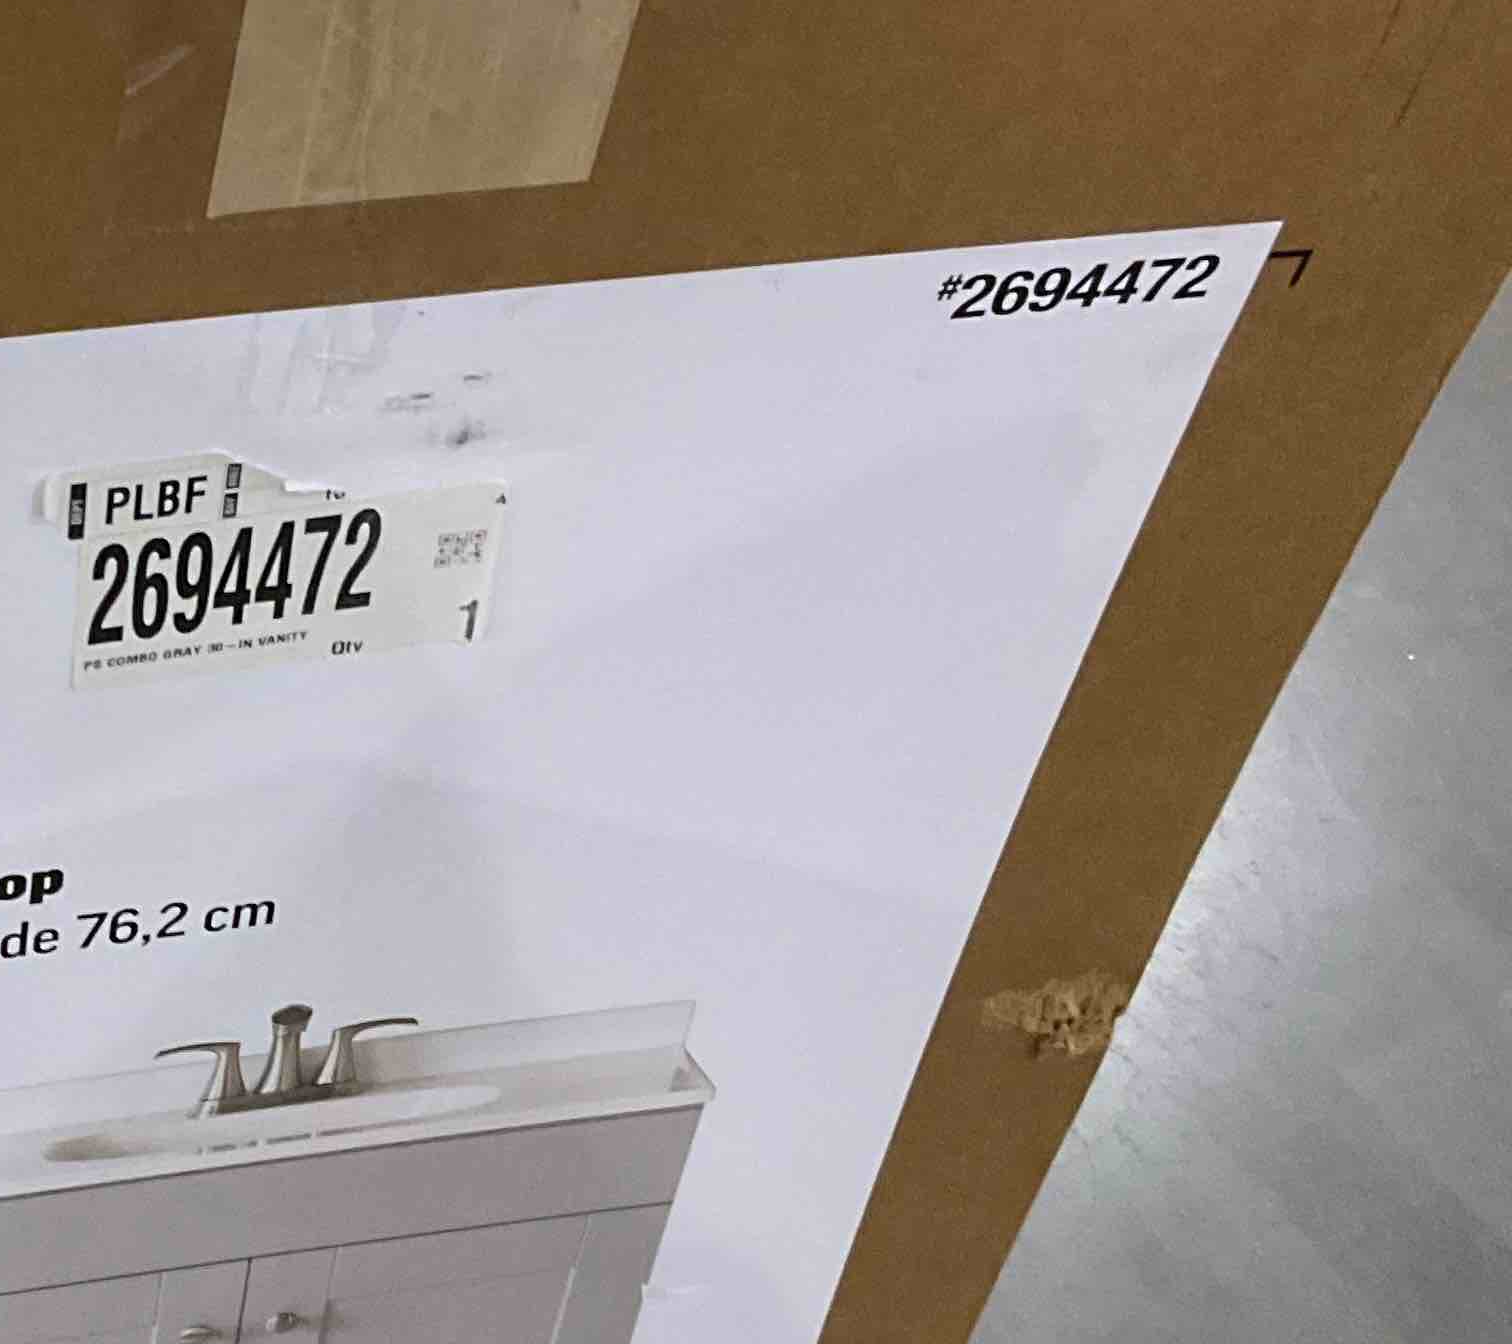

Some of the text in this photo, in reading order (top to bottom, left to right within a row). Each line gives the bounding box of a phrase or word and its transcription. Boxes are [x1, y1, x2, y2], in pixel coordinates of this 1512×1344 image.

[936, 254, 1220, 320] #2694472
[105, 475, 207, 524] PLBF
[87, 508, 382, 645] 2694472
[459, 600, 478, 642] 1
[107, 651, 158, 668] COMBO
[163, 644, 202, 660] GRAY
[258, 631, 308, 648] VANITY
[0, 921, 60, 958] de
[77, 901, 189, 949] 76,2
[203, 900, 275, 932] cm
